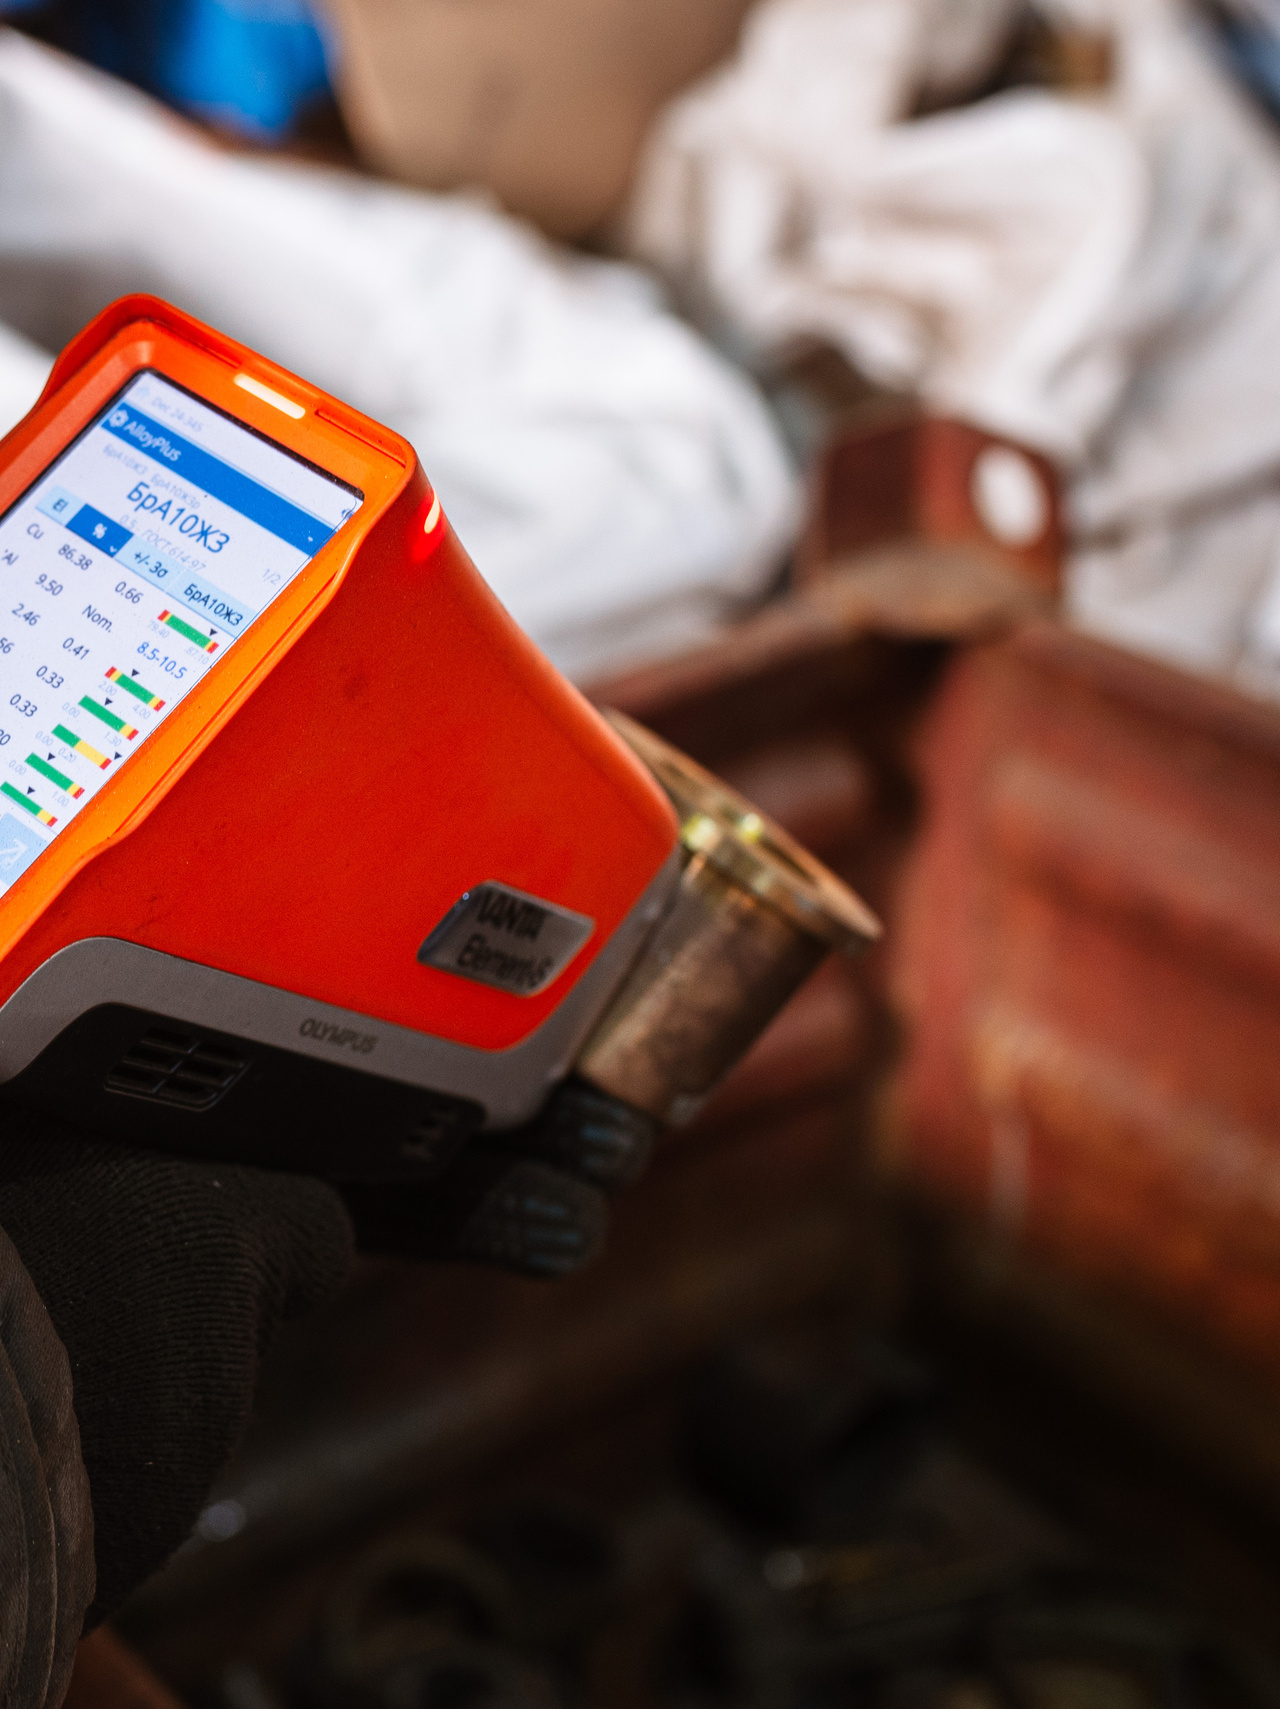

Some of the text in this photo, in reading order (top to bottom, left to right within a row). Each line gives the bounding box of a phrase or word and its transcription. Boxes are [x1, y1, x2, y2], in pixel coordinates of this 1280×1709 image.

[124, 420, 181, 460] AlloyPlus
[26, 523, 45, 540] Cu
[58, 544, 93, 571] 86.38
[114, 581, 144, 605] 0.66
[11, 603, 41, 627] 2.46
[62, 637, 90, 660] 0.41
[35, 573, 64, 597] 9.50
[82, 604, 114, 633] Nom.
[137, 641, 187, 679] 8.5-10.5
[35, 665, 65, 689] 0.33
[9, 693, 38, 717] 0.33
